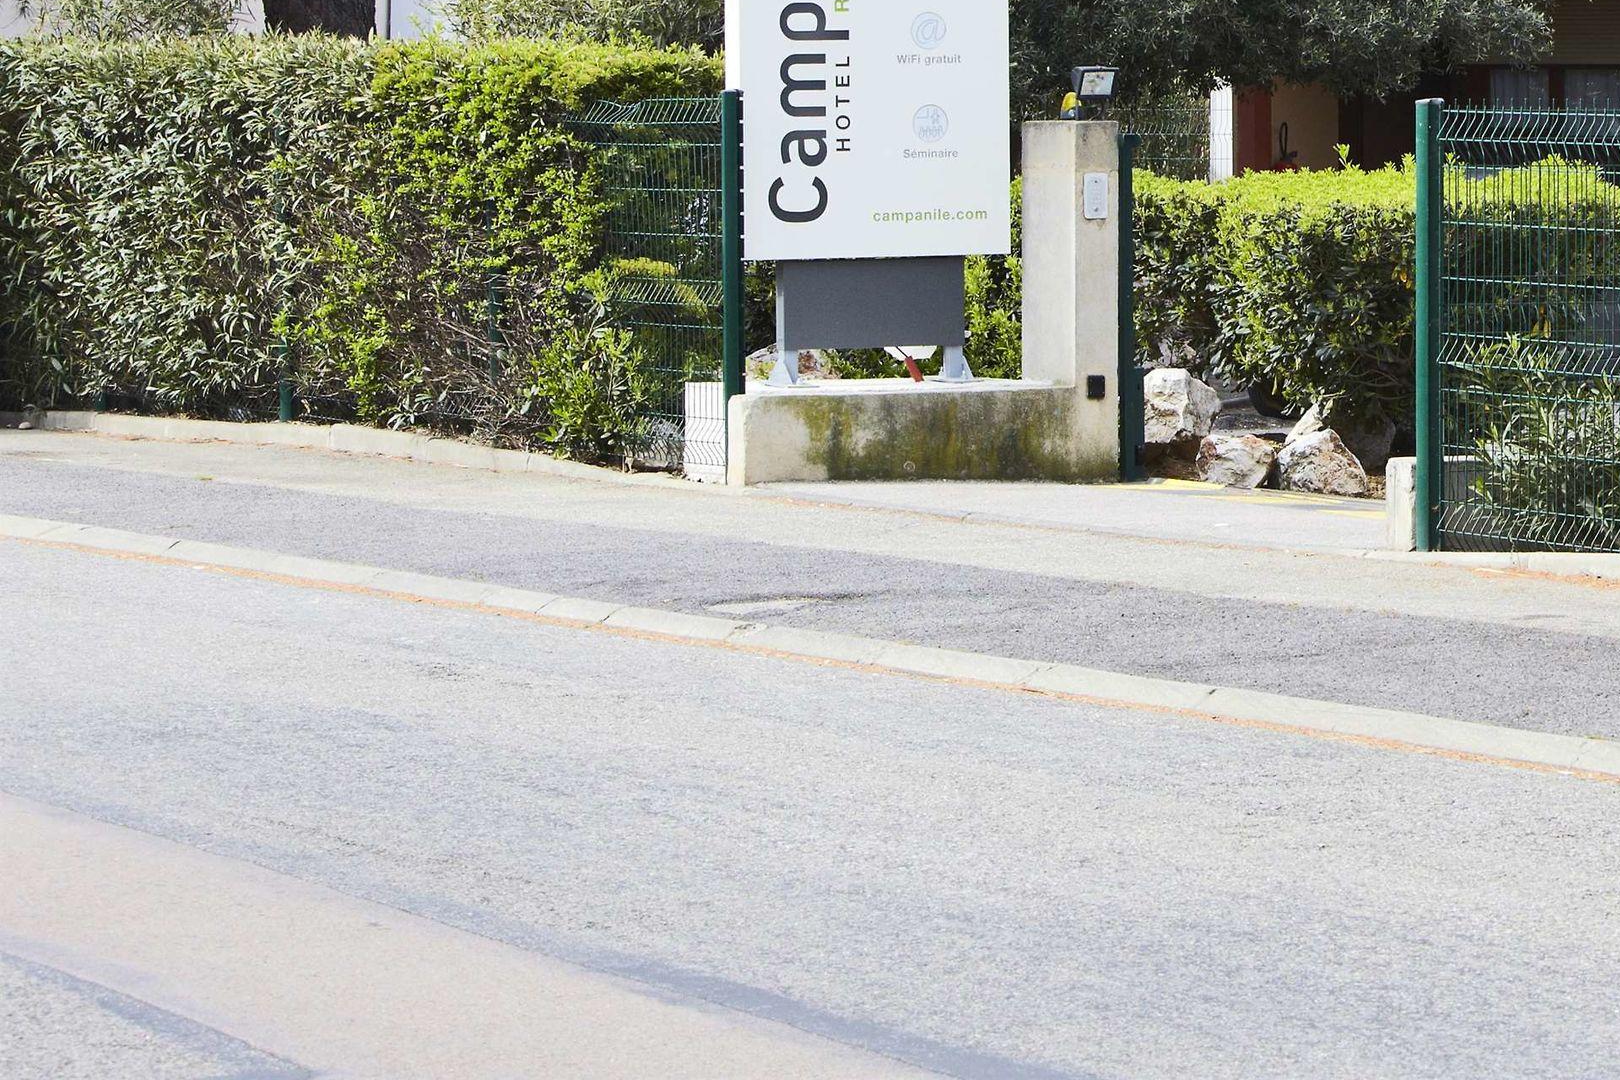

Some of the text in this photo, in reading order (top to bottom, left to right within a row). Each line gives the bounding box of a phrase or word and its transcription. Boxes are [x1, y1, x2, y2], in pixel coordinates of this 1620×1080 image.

[896, 54, 962, 66] WiFi gratuit
[835, 55, 852, 153] HOTEL
[902, 148, 959, 159] Séminaire
[872, 208, 989, 224] campanile.com
